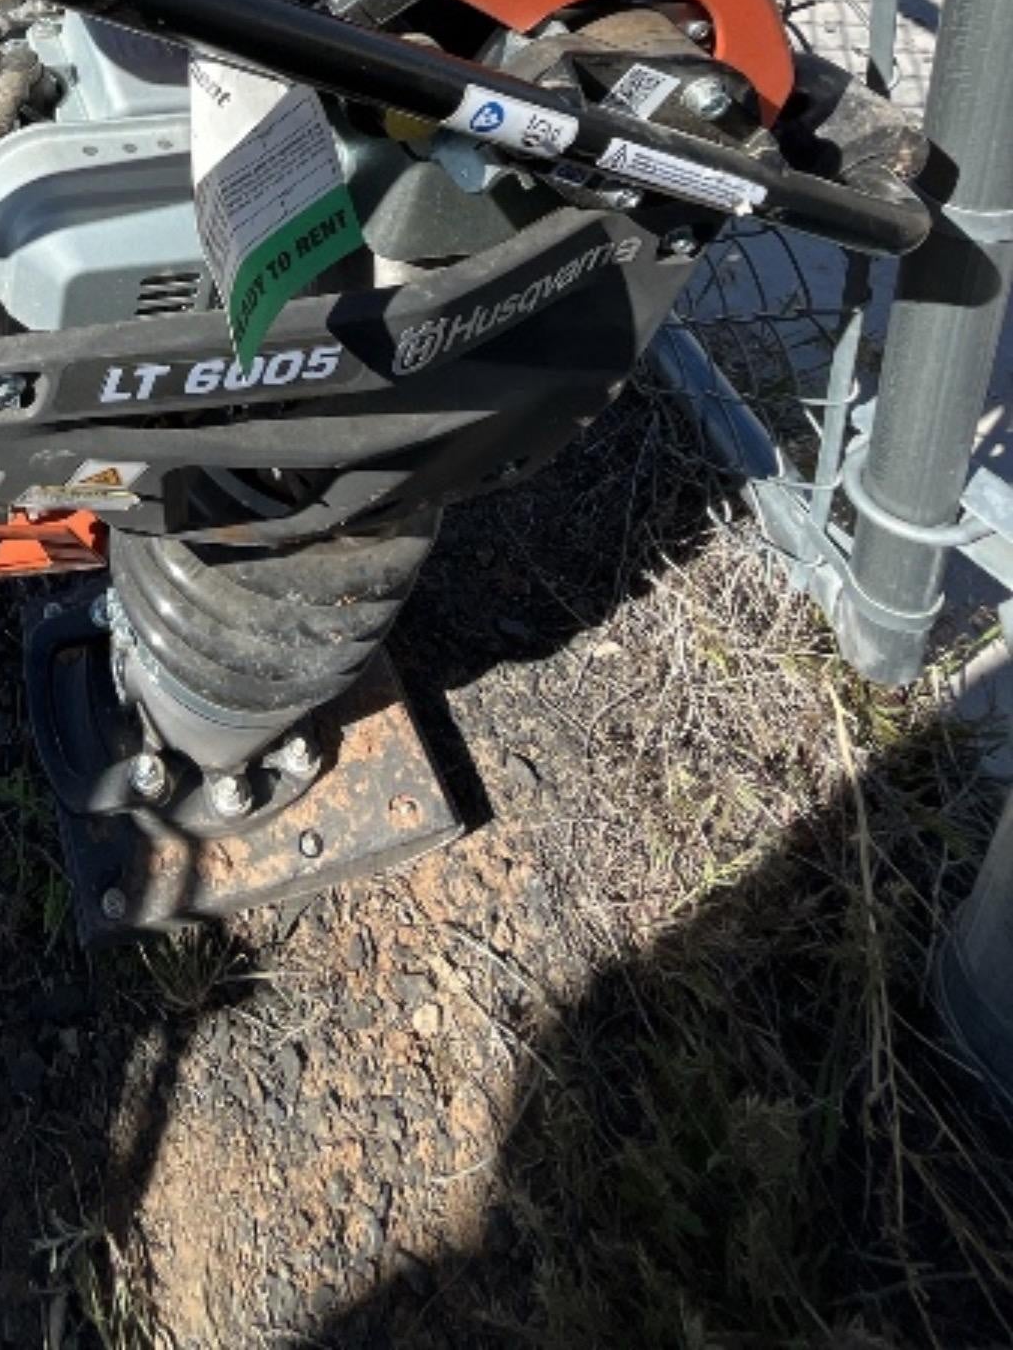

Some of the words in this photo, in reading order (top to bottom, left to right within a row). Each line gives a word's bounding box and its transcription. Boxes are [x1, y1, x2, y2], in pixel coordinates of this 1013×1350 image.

[265, 250, 291, 280] TO
[294, 209, 347, 258] RENT
[99, 363, 171, 403] LT
[184, 345, 342, 395] 6005
